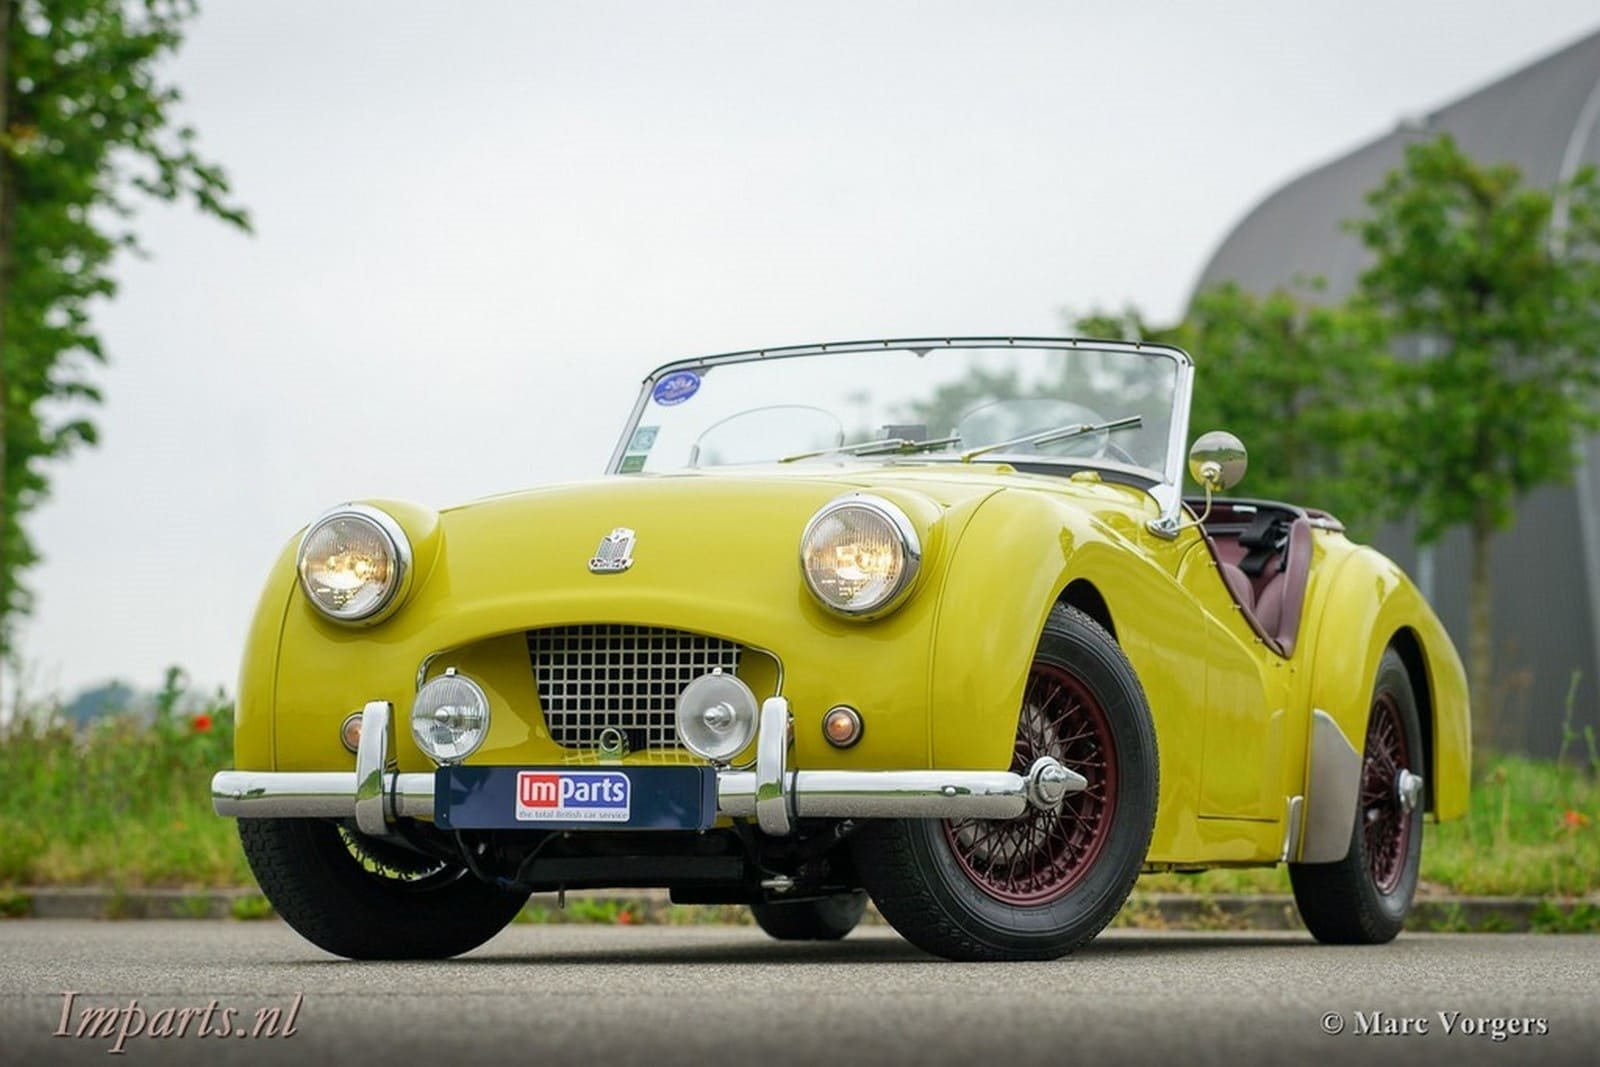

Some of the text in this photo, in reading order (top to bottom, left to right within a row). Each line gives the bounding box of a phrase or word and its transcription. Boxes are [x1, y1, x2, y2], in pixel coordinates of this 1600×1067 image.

[522, 777, 625, 803] ImParts
[535, 810, 553, 819] total
[584, 811, 597, 819] car
[599, 810, 628, 819] service
